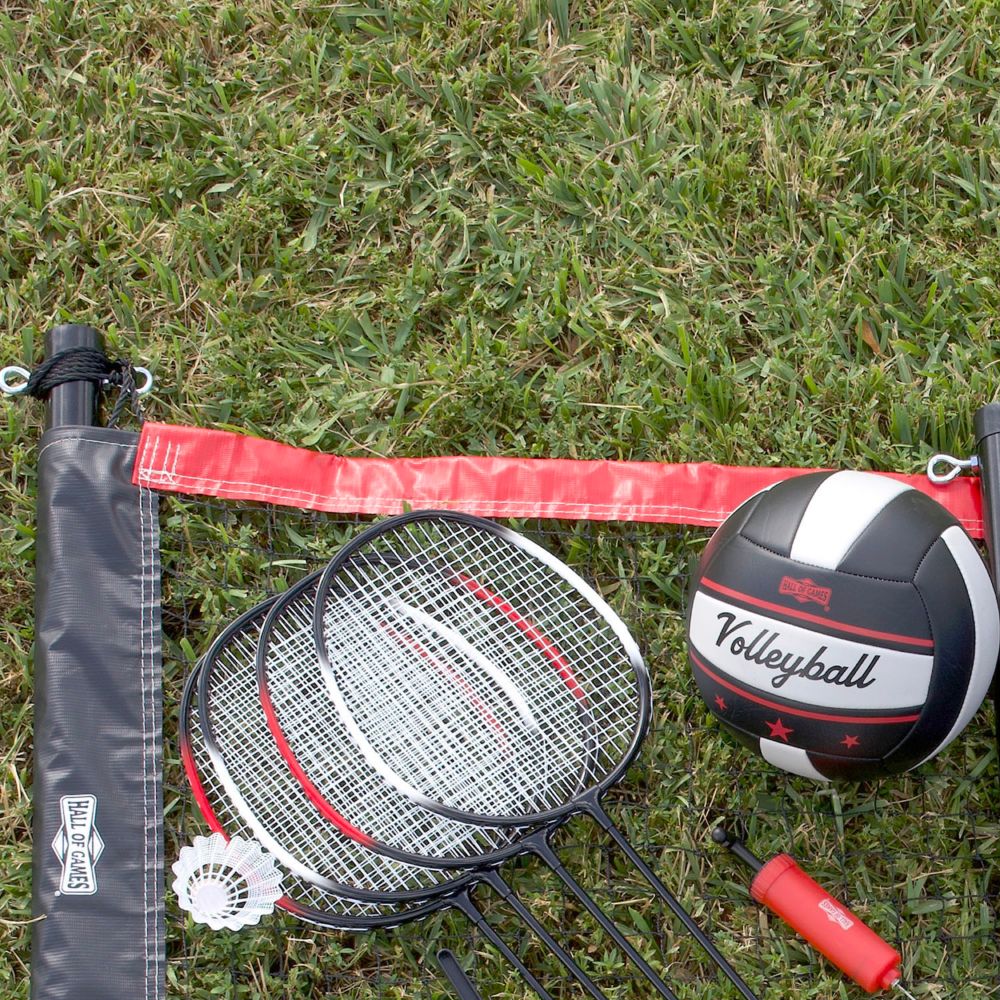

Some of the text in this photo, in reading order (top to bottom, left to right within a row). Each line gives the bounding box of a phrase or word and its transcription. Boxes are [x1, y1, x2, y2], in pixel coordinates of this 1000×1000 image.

[715, 611, 881, 689] Volleyball
[67, 800, 90, 889] HALL OF GAMES
